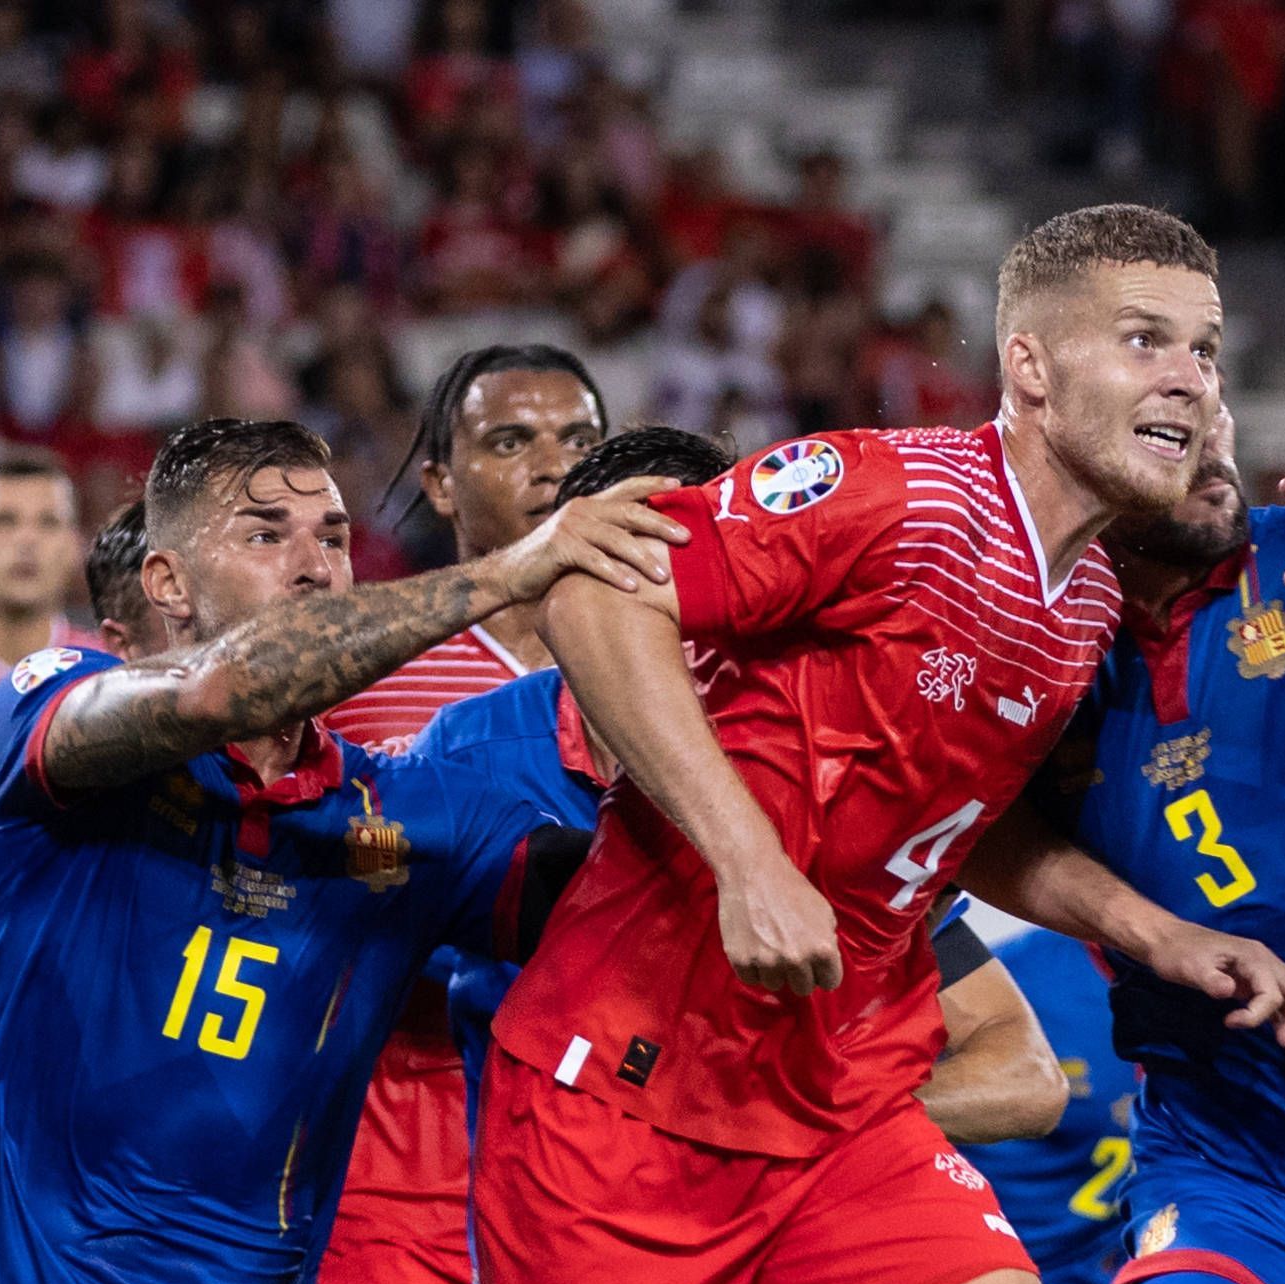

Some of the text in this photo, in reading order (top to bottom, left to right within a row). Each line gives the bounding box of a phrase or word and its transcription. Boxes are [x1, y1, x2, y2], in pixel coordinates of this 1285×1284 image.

[884, 800, 986, 911] 4
[1163, 788, 1257, 908] 3
[162, 925, 279, 1061] 15
